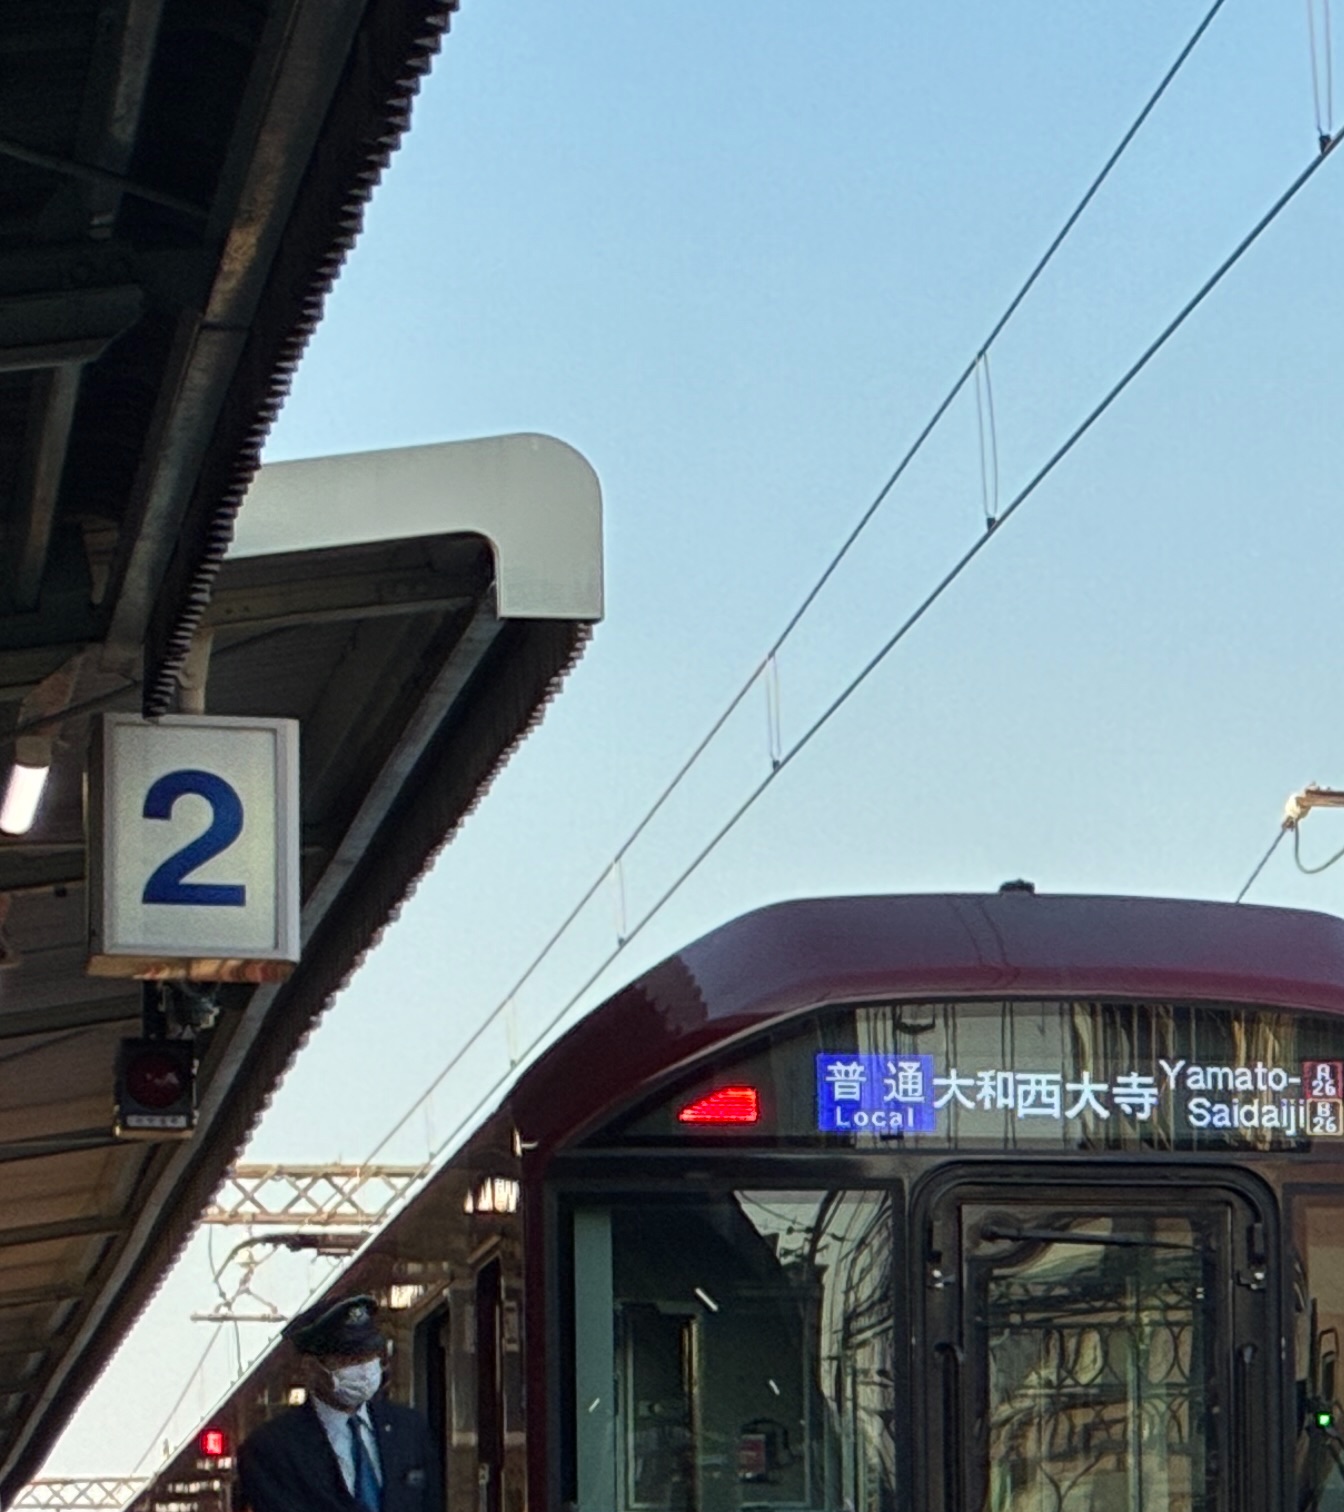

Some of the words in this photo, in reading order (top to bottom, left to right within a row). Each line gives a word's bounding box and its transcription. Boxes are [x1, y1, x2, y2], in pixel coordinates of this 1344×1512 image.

[142, 769, 246, 906] 2
[825, 1061, 925, 1104] 普通
[932, 1068, 1158, 1120] 大和西大寺
[1158, 1058, 1301, 1092] Yamato-
[835, 1106, 915, 1128] Local
[1187, 1097, 1305, 1136] Saidaiji
[1312, 1116, 1337, 1134] 26
